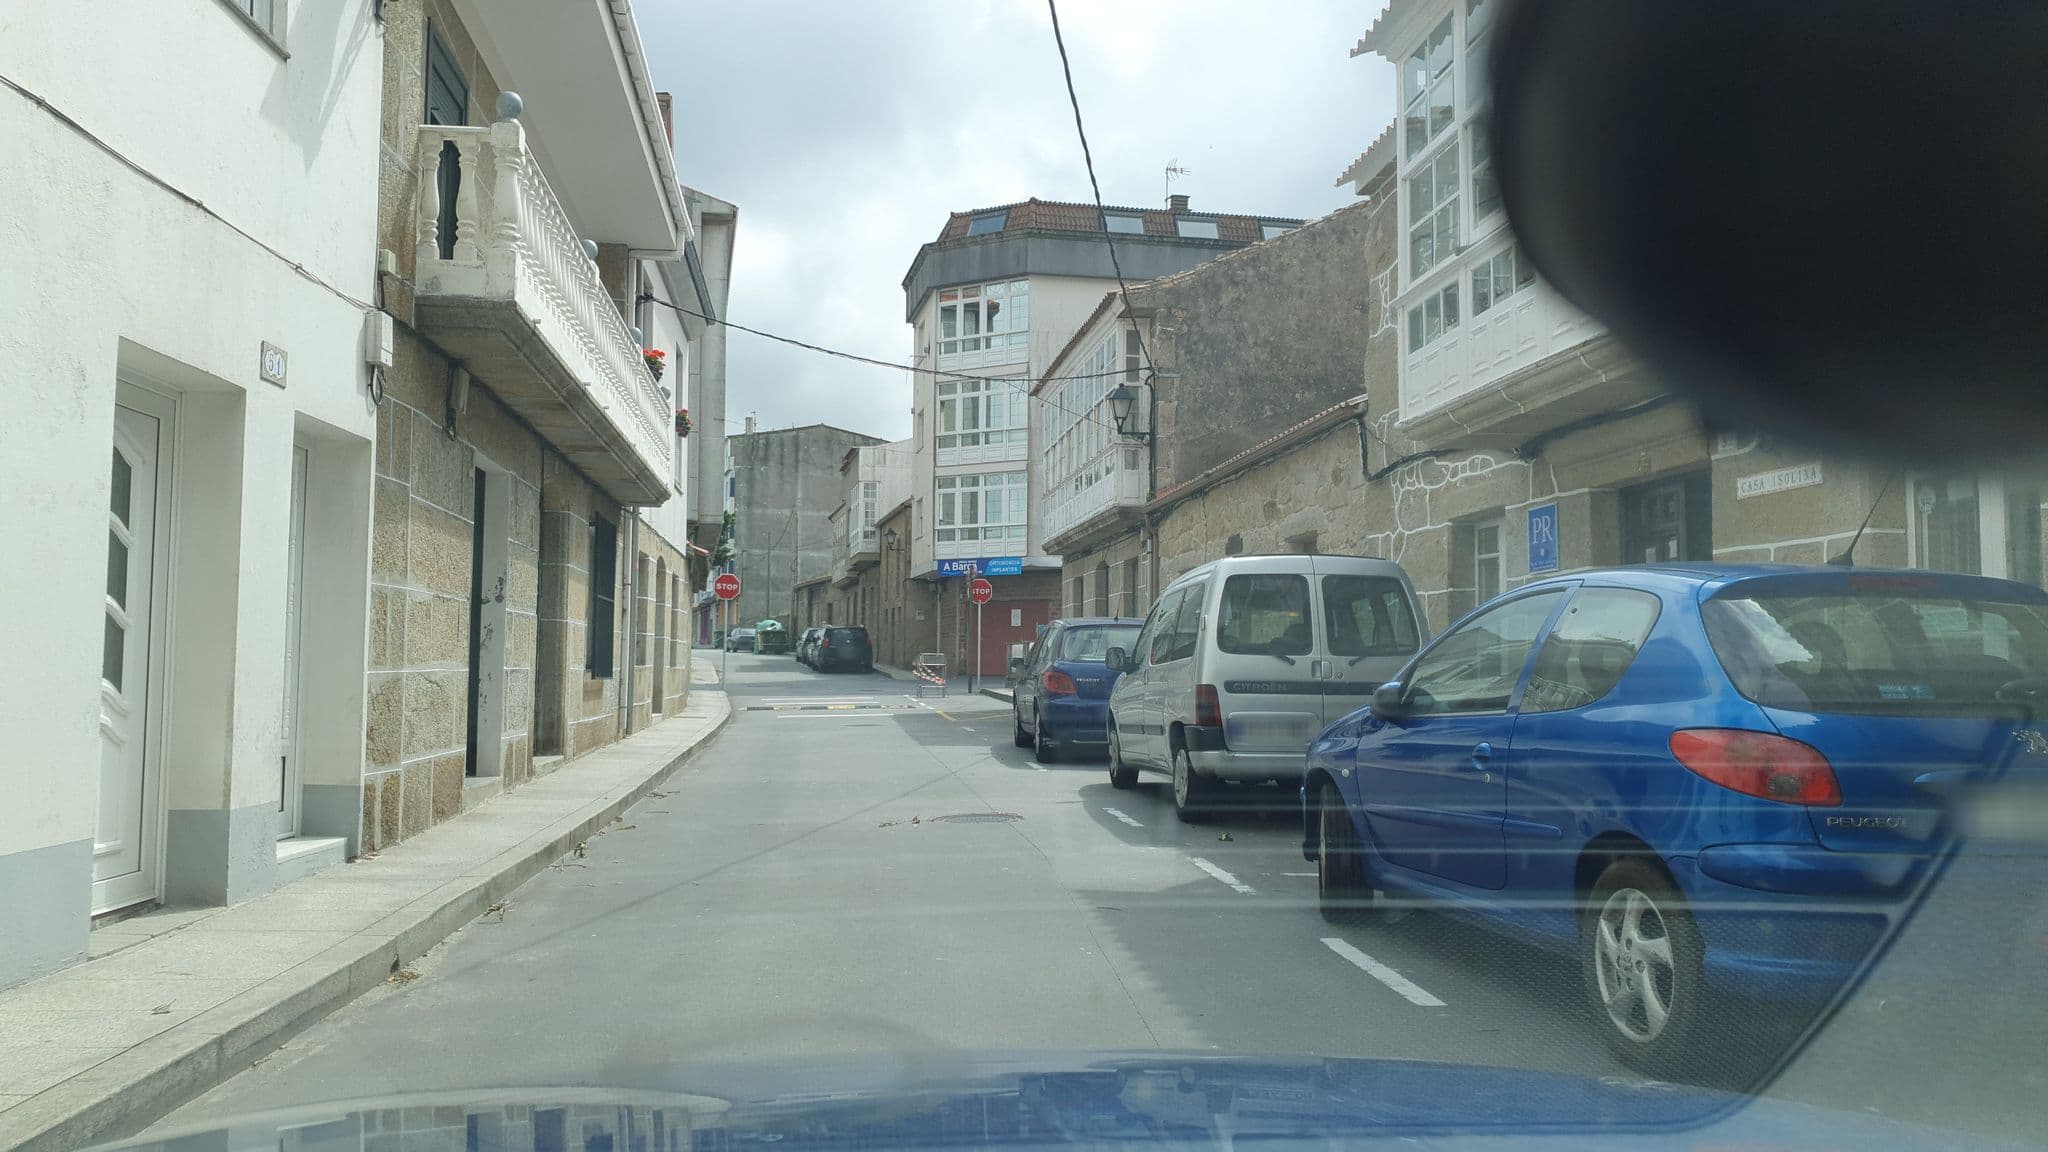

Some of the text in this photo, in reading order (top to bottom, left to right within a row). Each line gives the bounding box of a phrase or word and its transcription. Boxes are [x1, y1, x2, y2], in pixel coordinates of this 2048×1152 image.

[1741, 478, 1765, 494] CASA
[1532, 515, 1552, 545] PR
[943, 562, 951, 571] A
[716, 583, 738, 591] STOP
[1826, 816, 1908, 829] PEUGEOT
